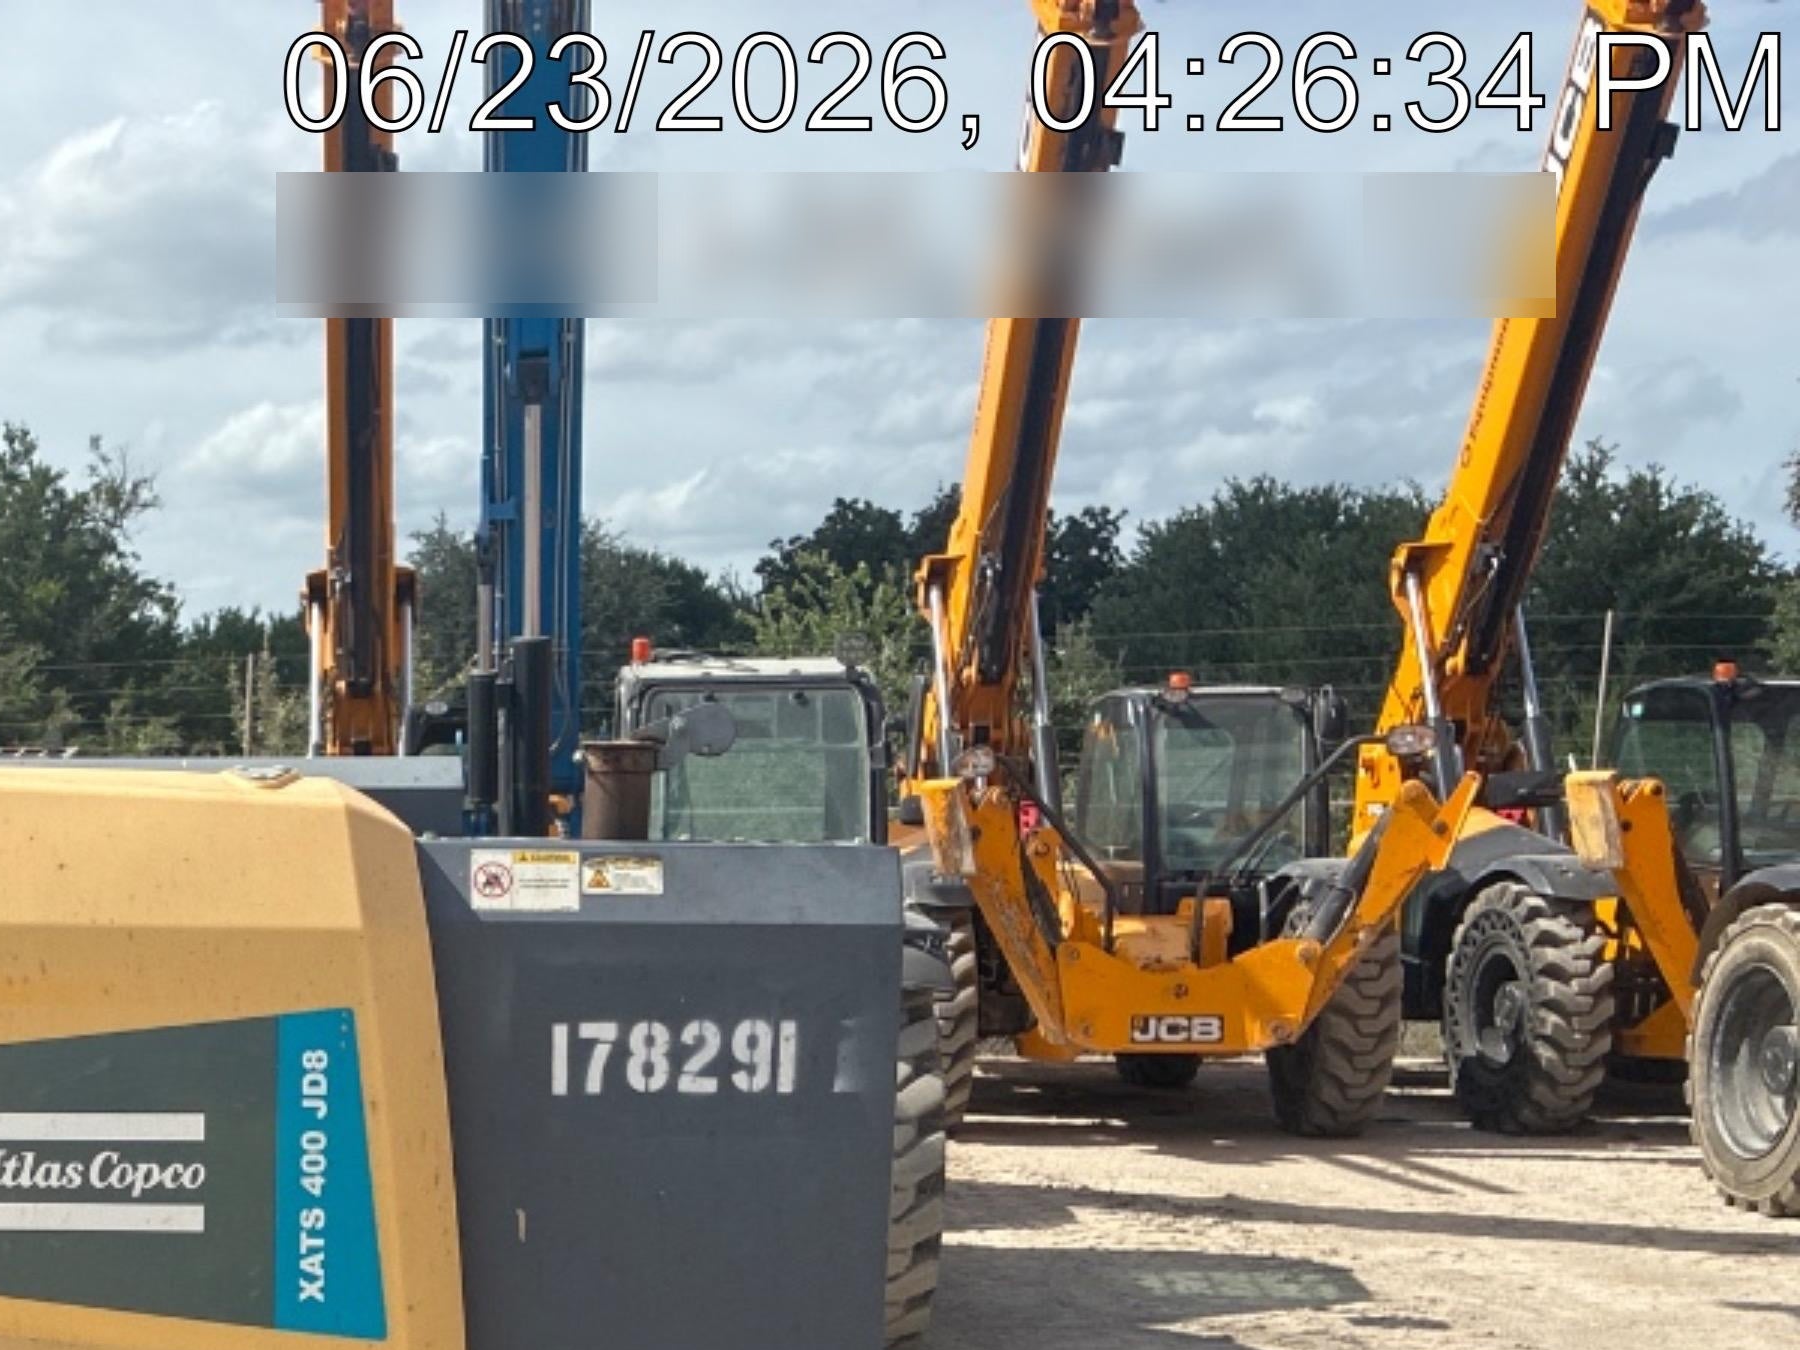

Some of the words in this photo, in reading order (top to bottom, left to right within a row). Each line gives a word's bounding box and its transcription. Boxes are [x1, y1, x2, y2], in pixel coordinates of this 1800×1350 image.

[551, 1019, 797, 1096] 178291
[1131, 1015, 1222, 1042] JCB
[302, 1048, 329, 1119] JD8
[89, 1151, 206, 1198] Copco
[301, 1130, 328, 1198] 400
[298, 1207, 326, 1303] XATS
